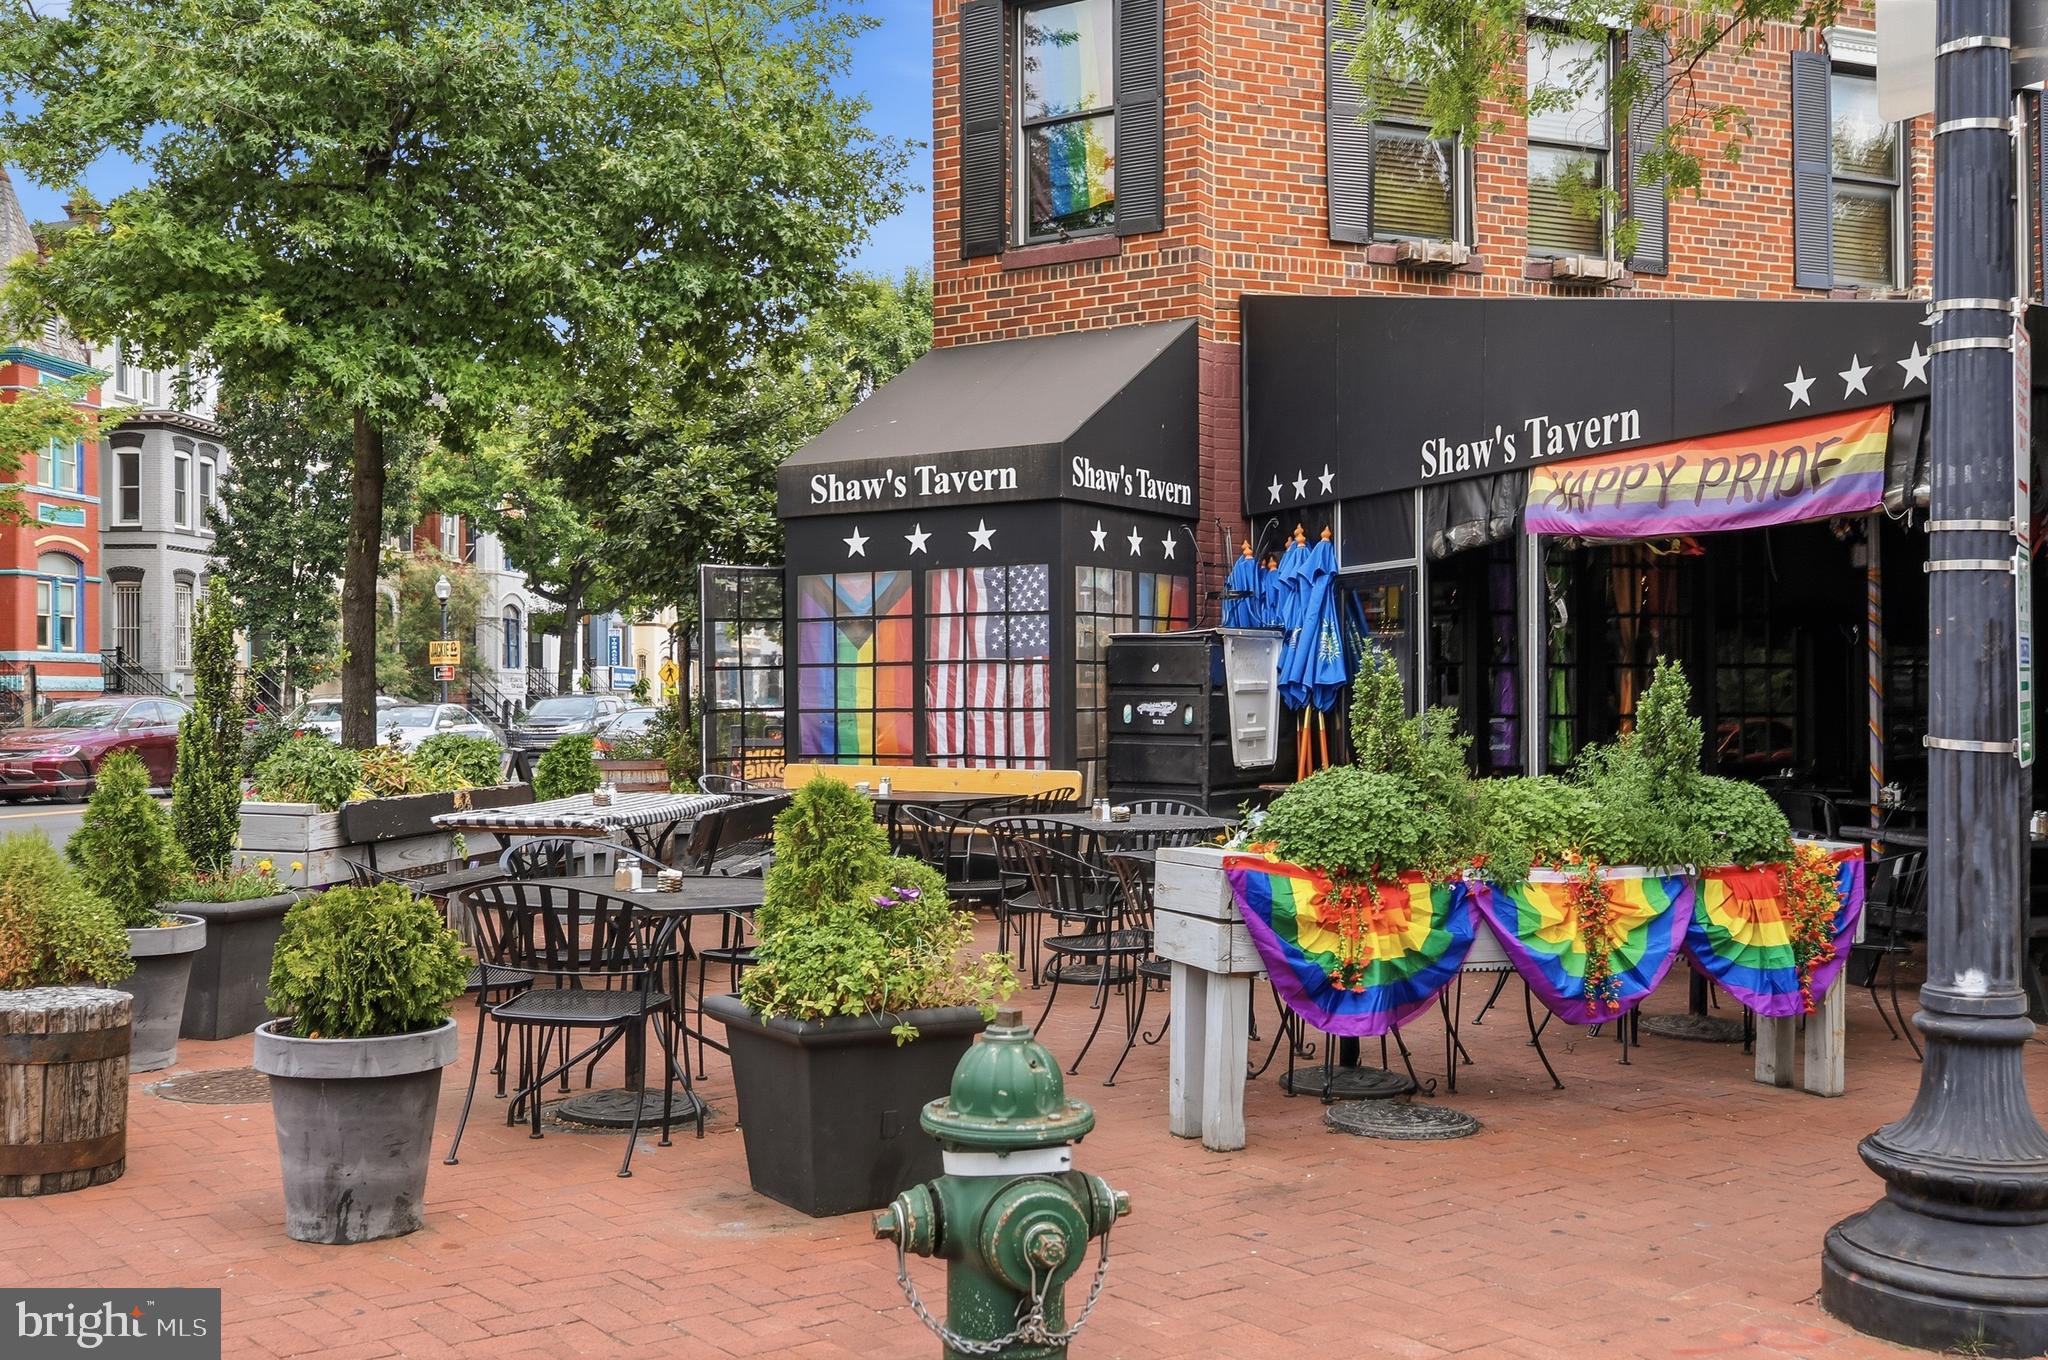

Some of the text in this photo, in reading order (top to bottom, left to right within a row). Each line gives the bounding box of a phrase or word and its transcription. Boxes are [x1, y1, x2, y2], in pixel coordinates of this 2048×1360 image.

[1421, 408, 1641, 479] Shaw's Tavern
[811, 465, 1018, 504] Shaw's Tavern
[1072, 455, 1192, 505] Shaw's Tavern
[1542, 436, 1843, 515] HAPPY PRIDE
